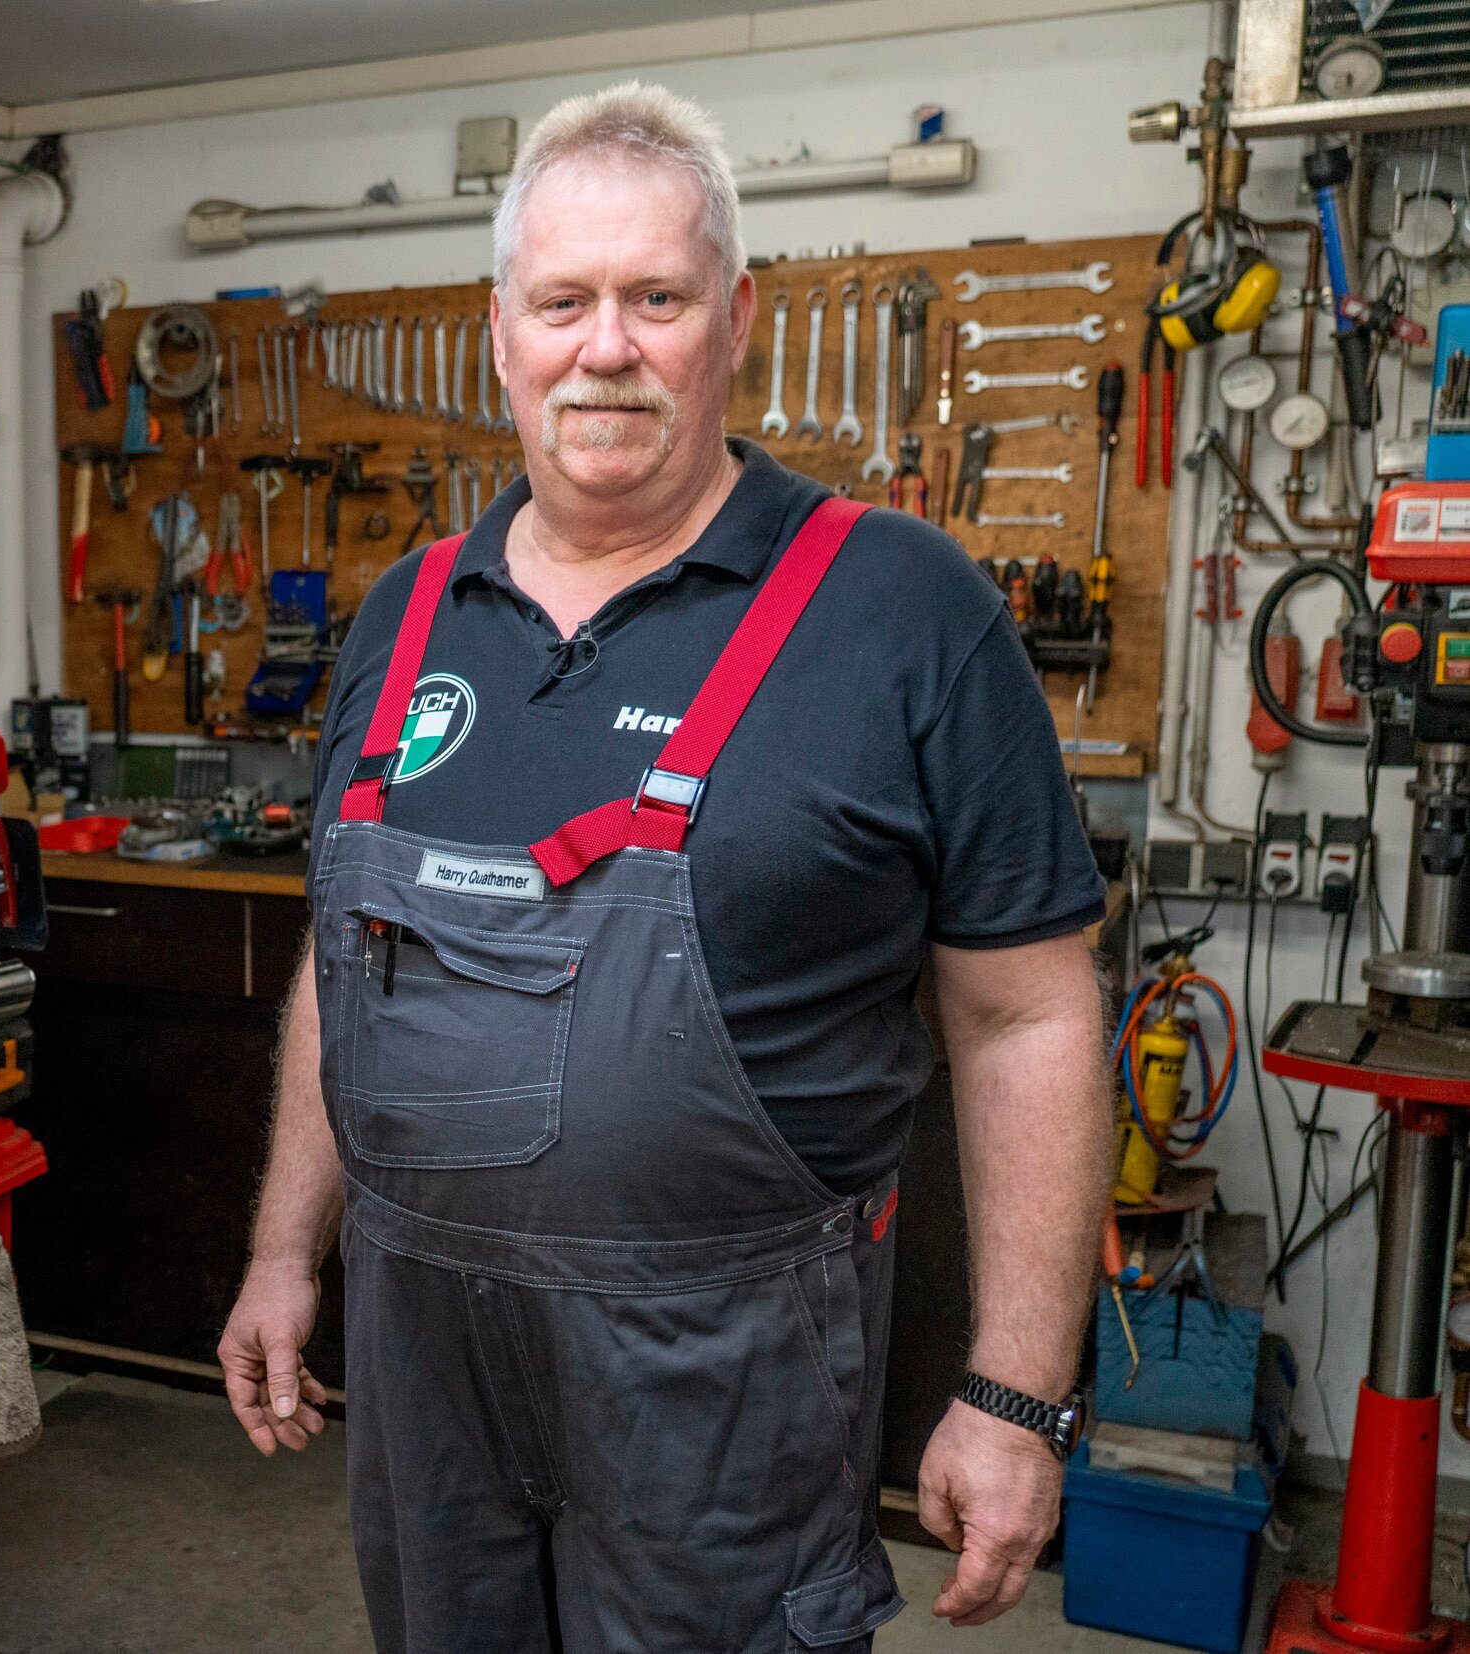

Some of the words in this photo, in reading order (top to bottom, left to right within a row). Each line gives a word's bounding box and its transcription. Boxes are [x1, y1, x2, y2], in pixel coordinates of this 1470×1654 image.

[407, 691, 461, 715] UCH
[613, 706, 683, 734] Har
[436, 865, 467, 886] Harry
[468, 870, 529, 888] Quathamer
